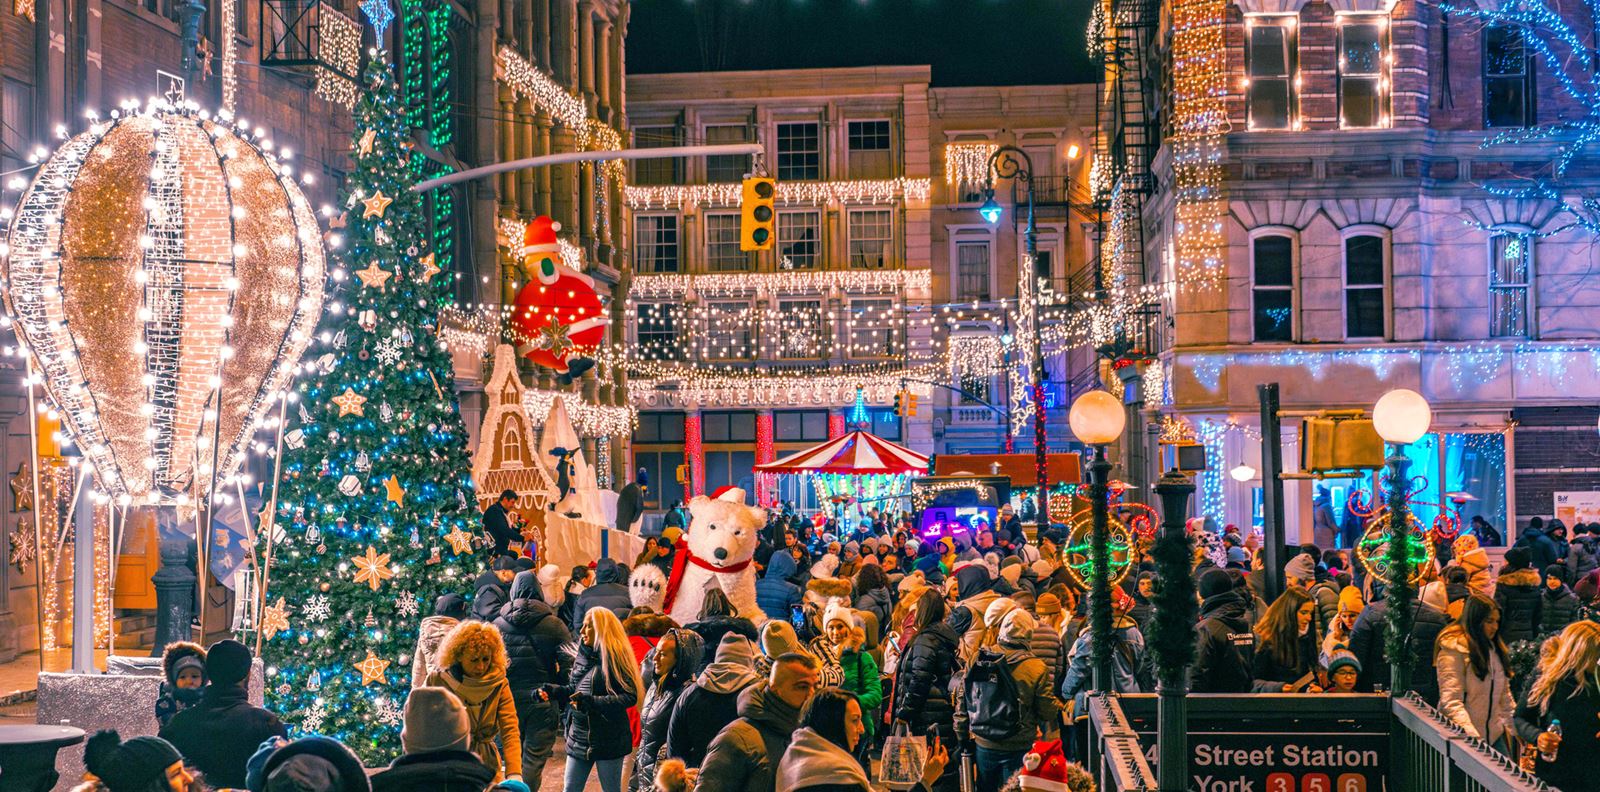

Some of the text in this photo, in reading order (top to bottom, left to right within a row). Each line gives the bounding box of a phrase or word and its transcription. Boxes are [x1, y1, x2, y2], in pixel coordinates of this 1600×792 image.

[631, 389, 886, 407] CONVENIENCE STORE
[1140, 743, 1378, 766] 4 Street Station
[1193, 775, 1358, 792] York 3 5 6
